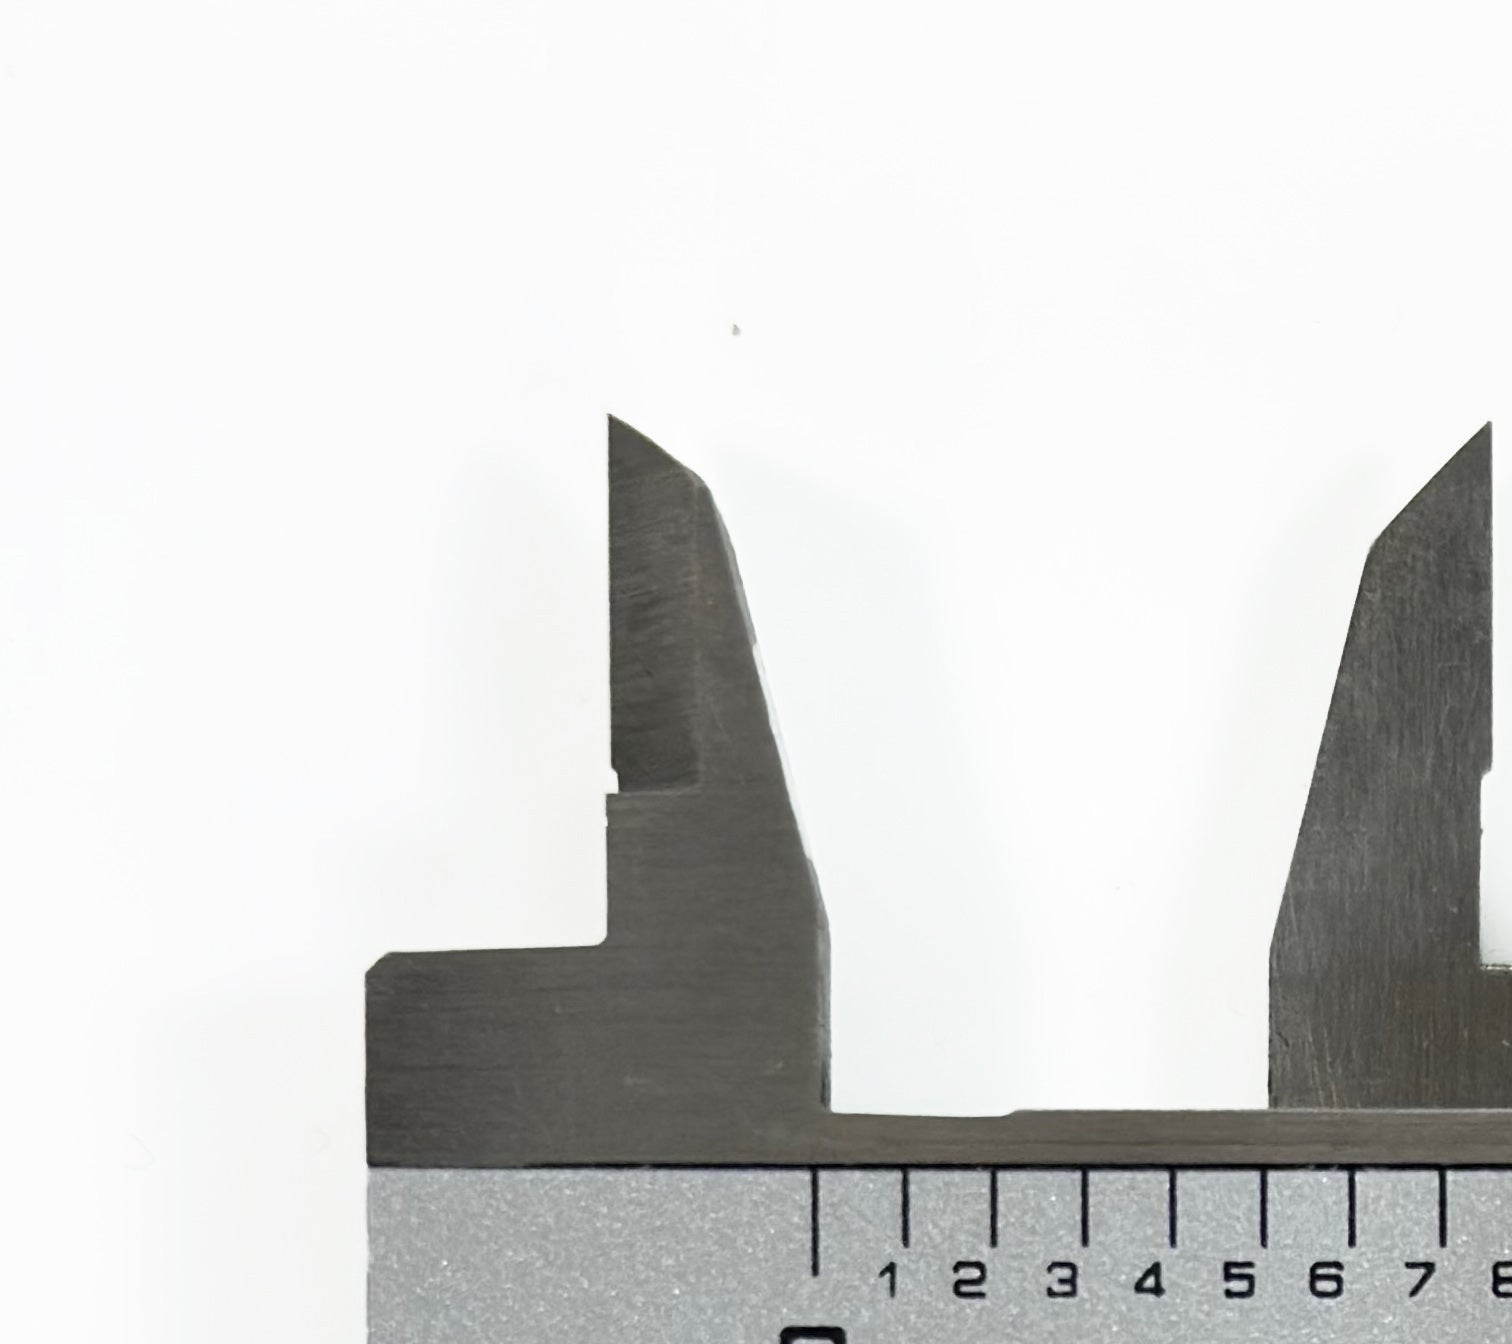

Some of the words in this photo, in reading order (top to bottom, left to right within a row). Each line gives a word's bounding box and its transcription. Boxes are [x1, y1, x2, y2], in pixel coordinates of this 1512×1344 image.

[878, 1260, 898, 1299] 1
[951, 1259, 988, 1301] 2
[1045, 1260, 1079, 1300] 3
[1132, 1260, 1167, 1299] 4
[1221, 1259, 1257, 1300] 5
[1307, 1259, 1346, 1300] 6
[1403, 1260, 1437, 1299] 7
